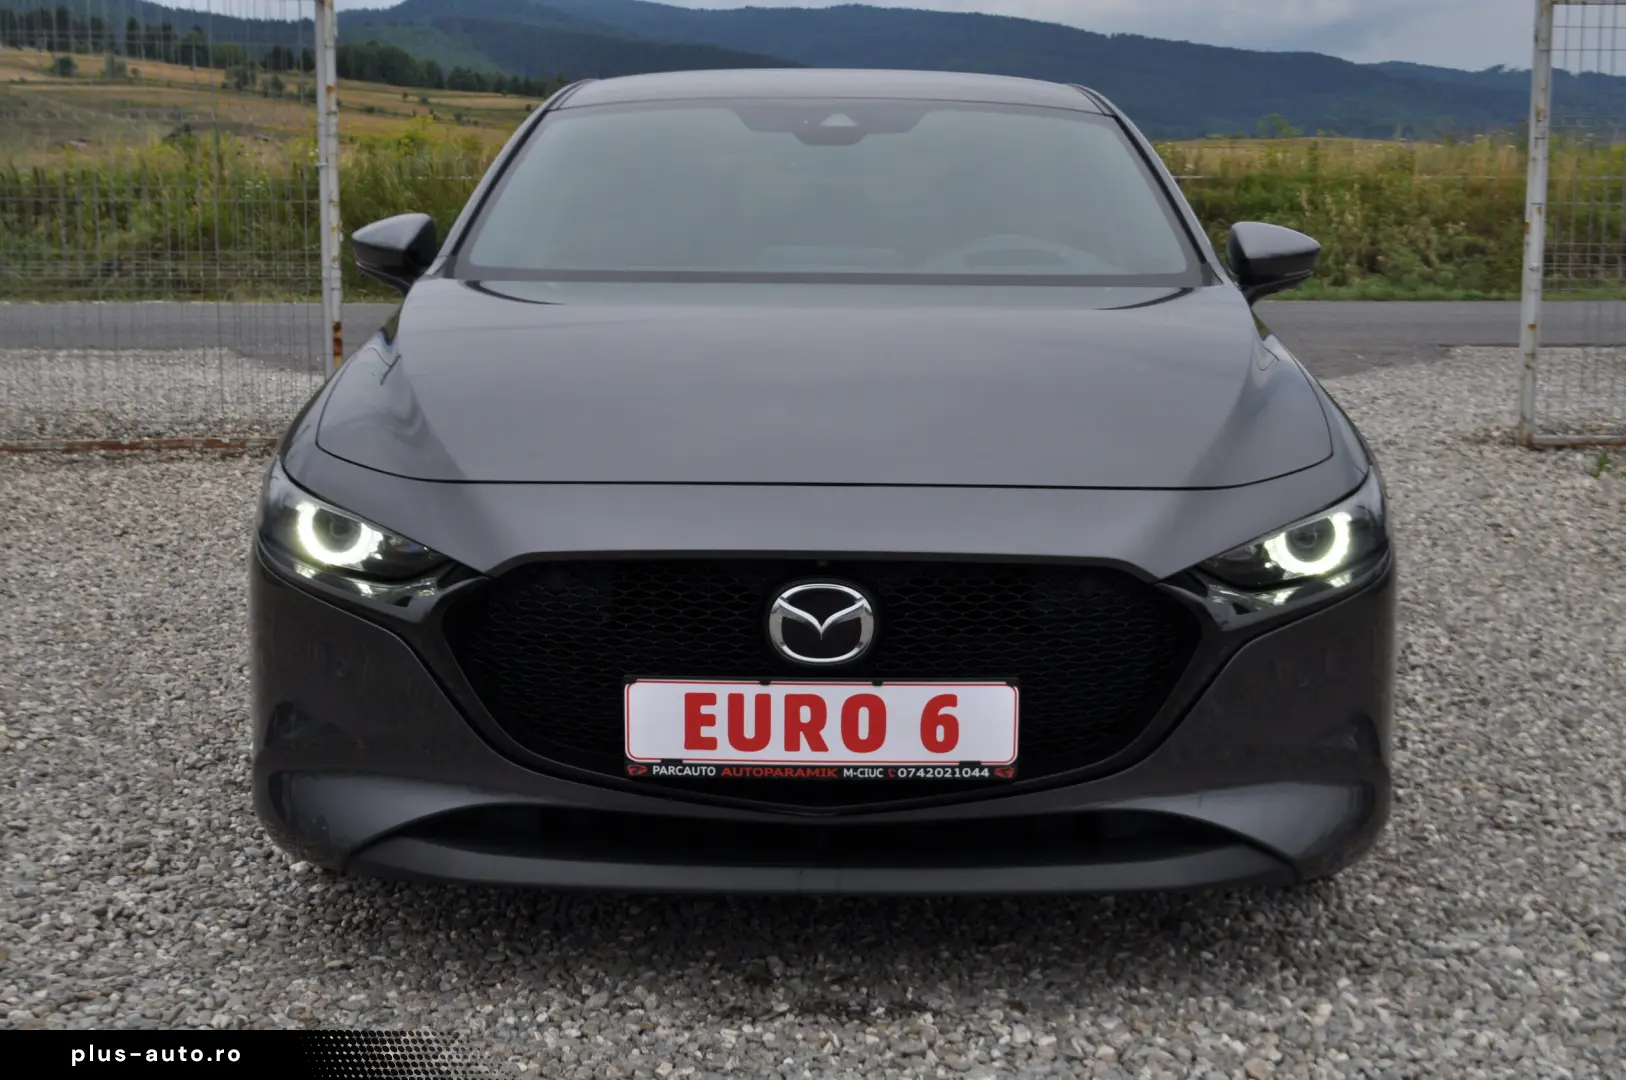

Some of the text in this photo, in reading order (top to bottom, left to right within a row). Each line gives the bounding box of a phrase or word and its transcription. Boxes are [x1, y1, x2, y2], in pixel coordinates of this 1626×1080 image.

[684, 692, 959, 754] EURO 6
[652, 764, 990, 779] PARCAUTO AUTOPARAMIK M-CIUC 0742021044
